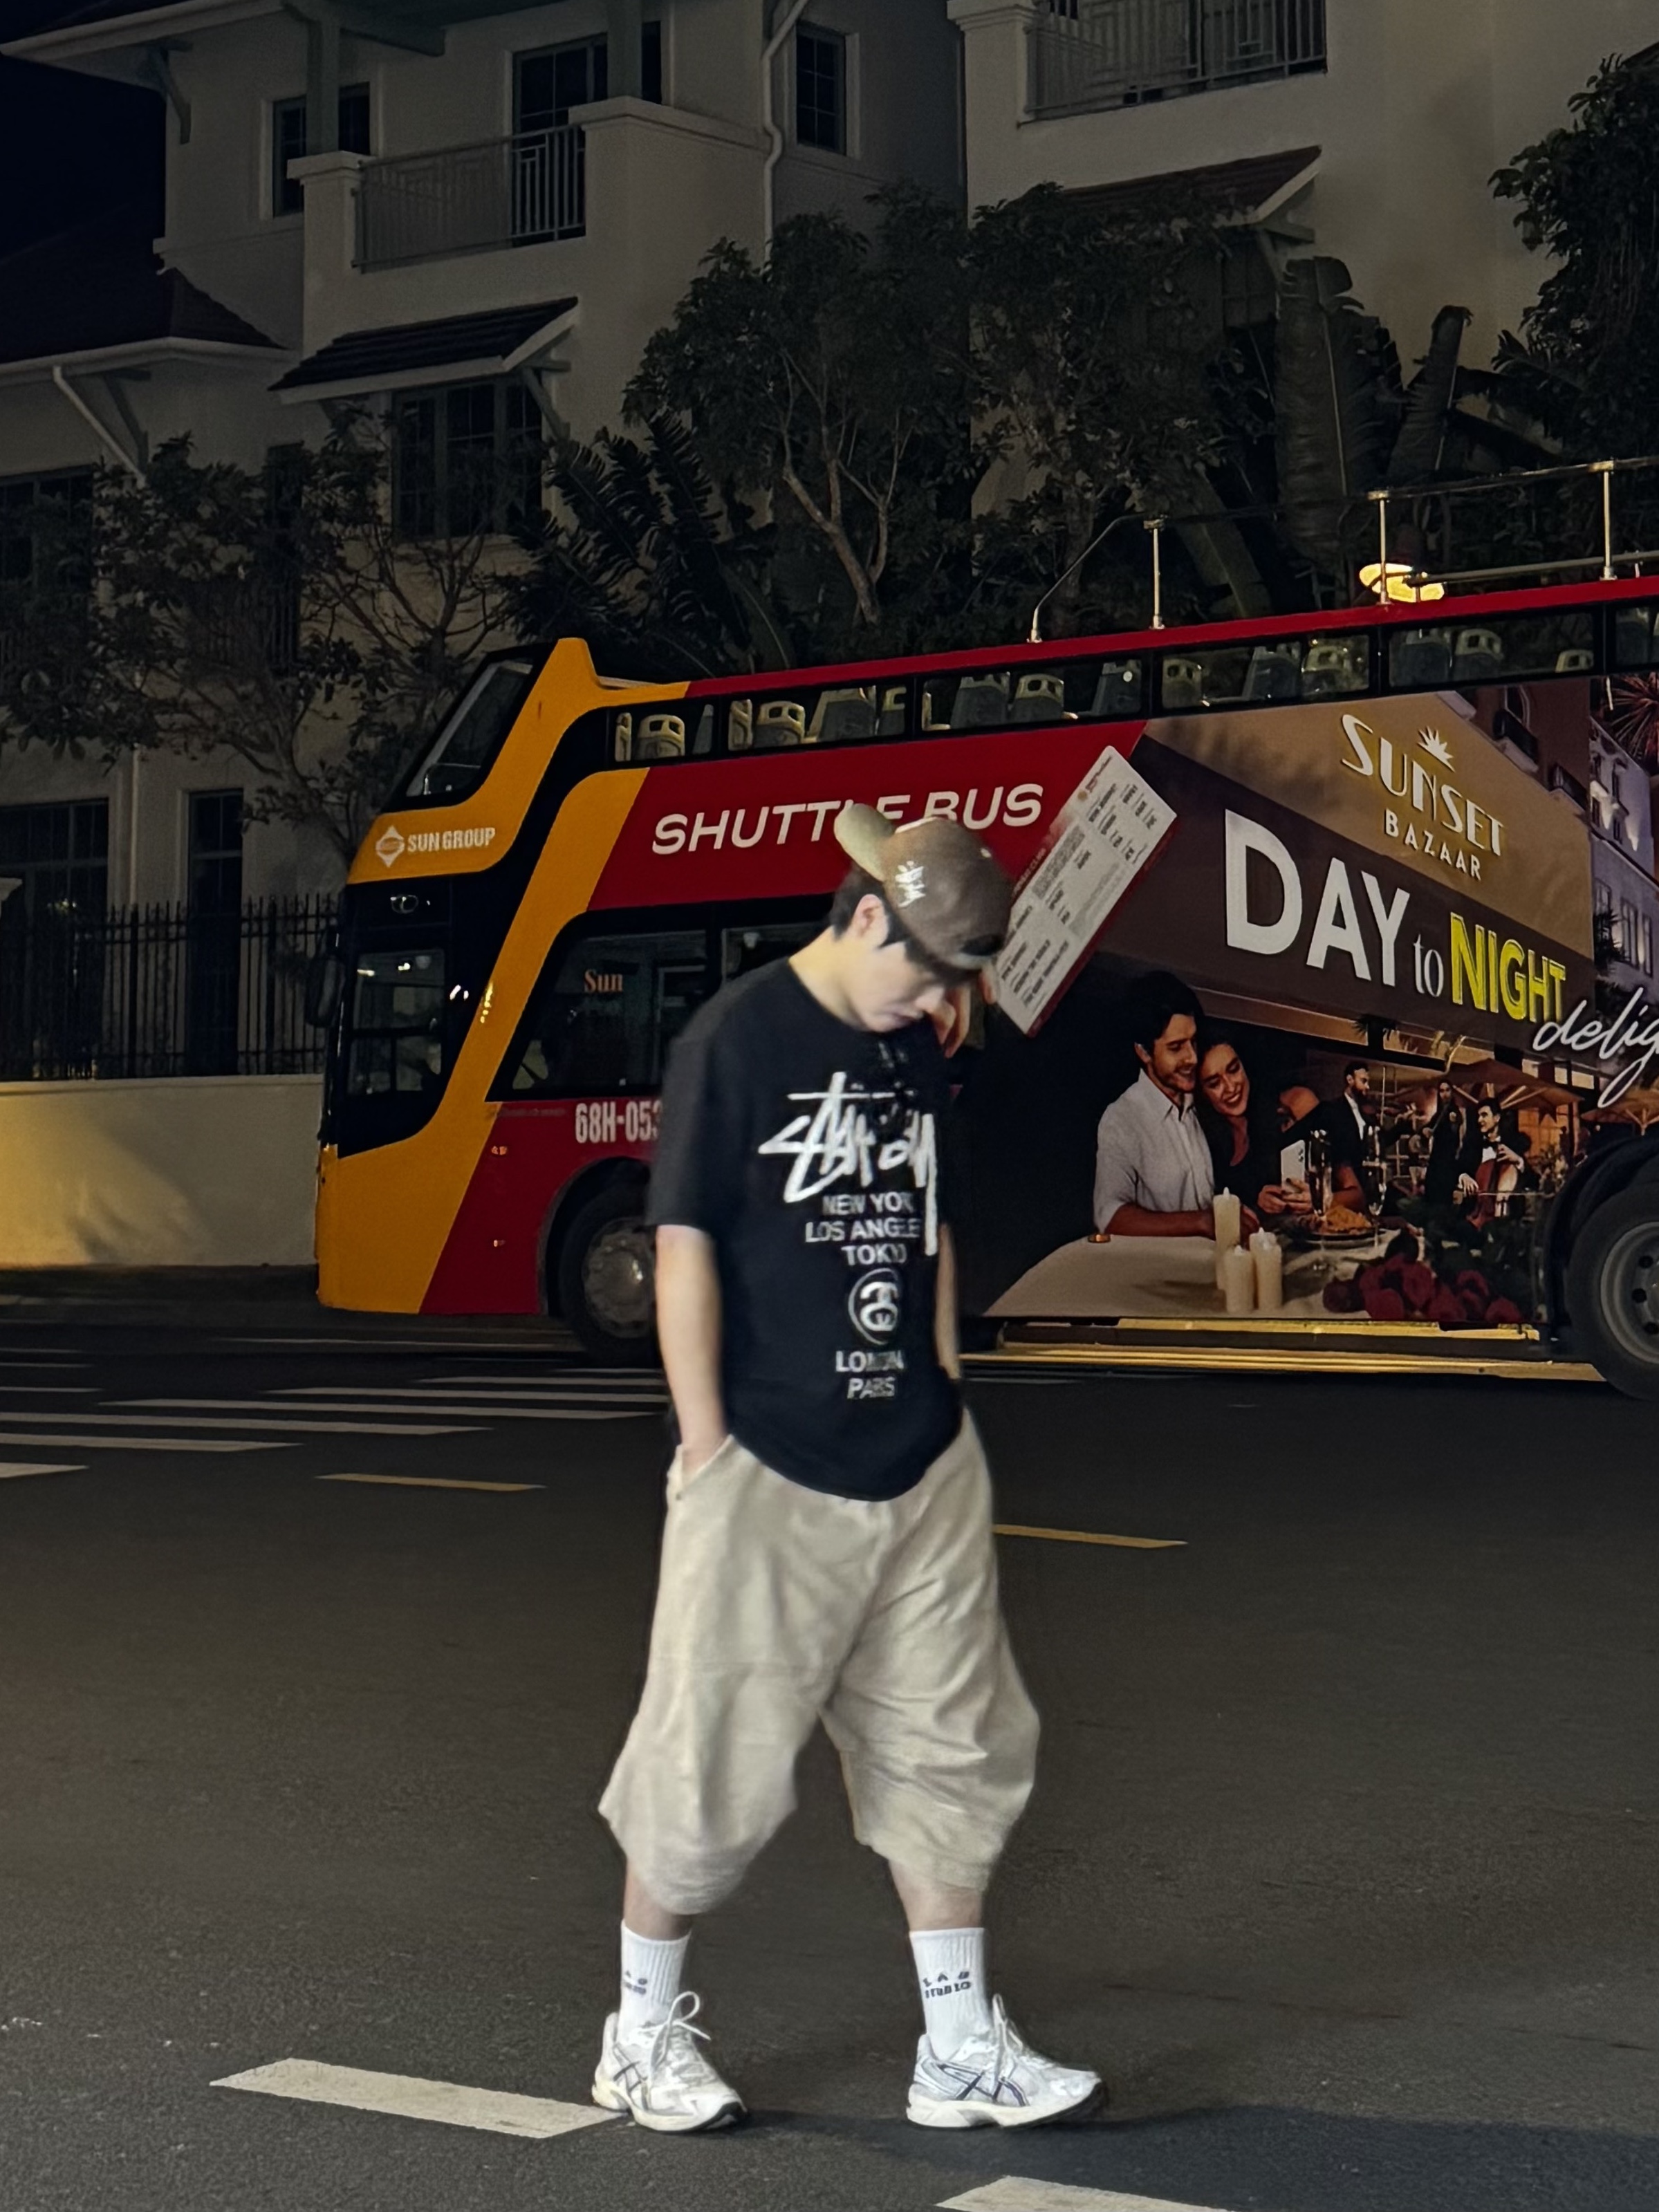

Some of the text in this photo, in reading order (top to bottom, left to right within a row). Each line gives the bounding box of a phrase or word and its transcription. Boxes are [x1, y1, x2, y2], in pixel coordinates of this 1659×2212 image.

[652, 794, 911, 855] SHUTTE
[923, 783, 1044, 830] BUS
[1342, 714, 1505, 857] SUNSET
[407, 827, 496, 853] SUN GROUP
[1384, 807, 1482, 882] BAZAAR
[1225, 808, 1411, 987] DAY
[1412, 933, 1445, 999] to
[1449, 911, 1566, 1024] NIGHT
[584, 969, 623, 994] Sun
[805, 1220, 845, 1243] LOS
